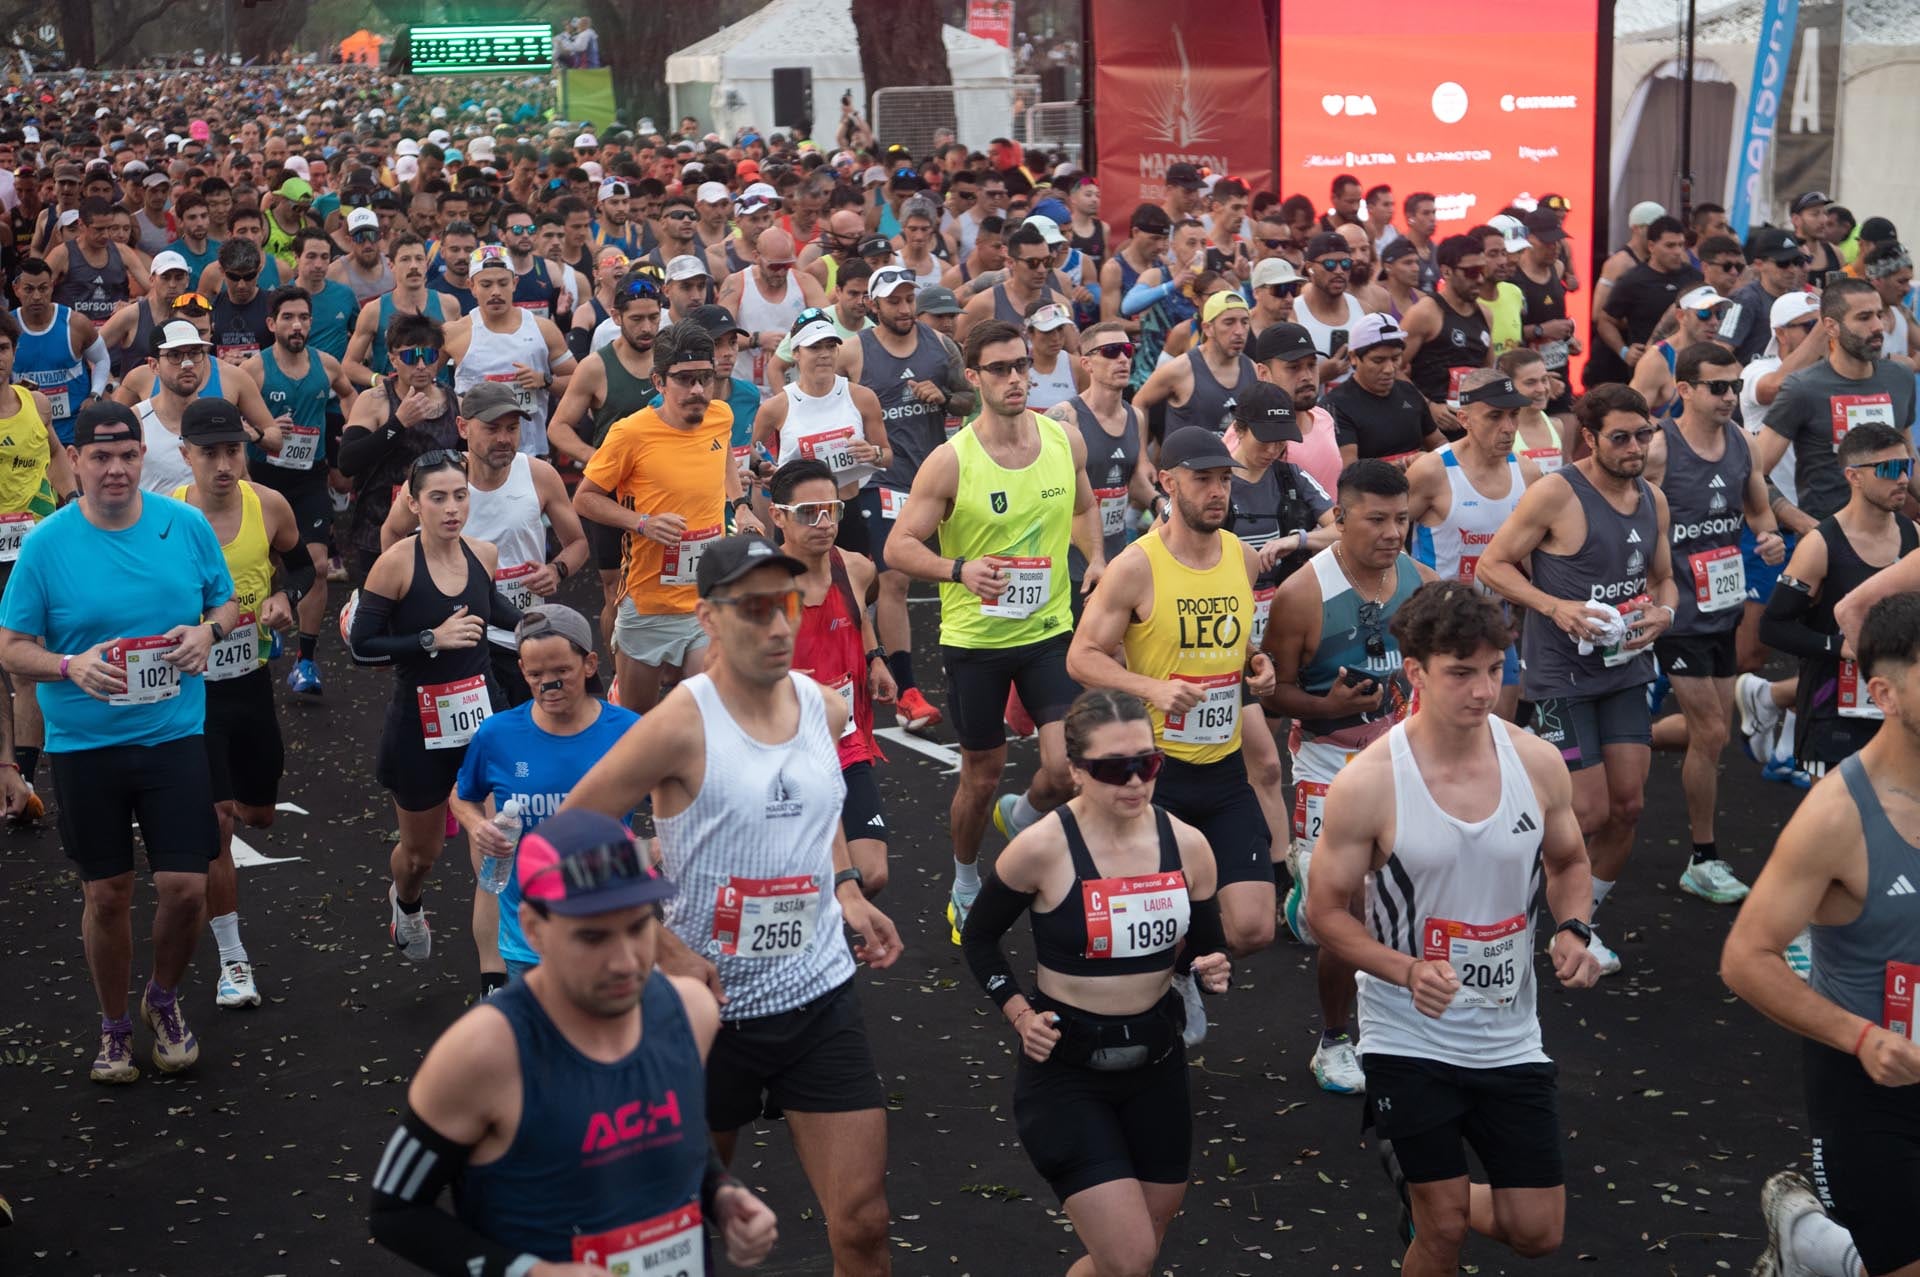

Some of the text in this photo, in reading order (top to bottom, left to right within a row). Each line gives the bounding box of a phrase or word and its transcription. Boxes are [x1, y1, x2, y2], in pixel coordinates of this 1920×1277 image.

[1790, 27, 1820, 133] A
[1354, 153, 1397, 166] ULTRA
[1406, 150, 1491, 163] LEAPMOTOR
[1267, 408, 1290, 416] nox
[285, 445, 312, 459] 2067
[1041, 487, 1067, 499] BORA
[0, 535, 22, 551] 214
[1019, 572, 1044, 581] RODRIGO
[1716, 572, 1740, 595] 2297
[1006, 585, 1043, 605] 2137
[1177, 595, 1239, 615] PROJETO
[1178, 614, 1241, 648] LEO
[112, 646, 121, 660] C
[214, 643, 251, 667] 2476
[138, 666, 175, 689] 1021
[423, 692, 431, 707] C
[1209, 689, 1235, 702] ANTONIO
[450, 707, 485, 732] 1019
[1197, 704, 1234, 729] 1634
[724, 887, 736, 908] C
[1090, 891, 1102, 912] C
[1143, 897, 1173, 912] LAURA
[752, 919, 802, 952] 2556
[1127, 917, 1178, 950] 1939
[1431, 928, 1442, 947] C
[1483, 939, 1514, 958] GASPAR
[1462, 958, 1515, 988] 2045
[1894, 974, 1906, 995] C
